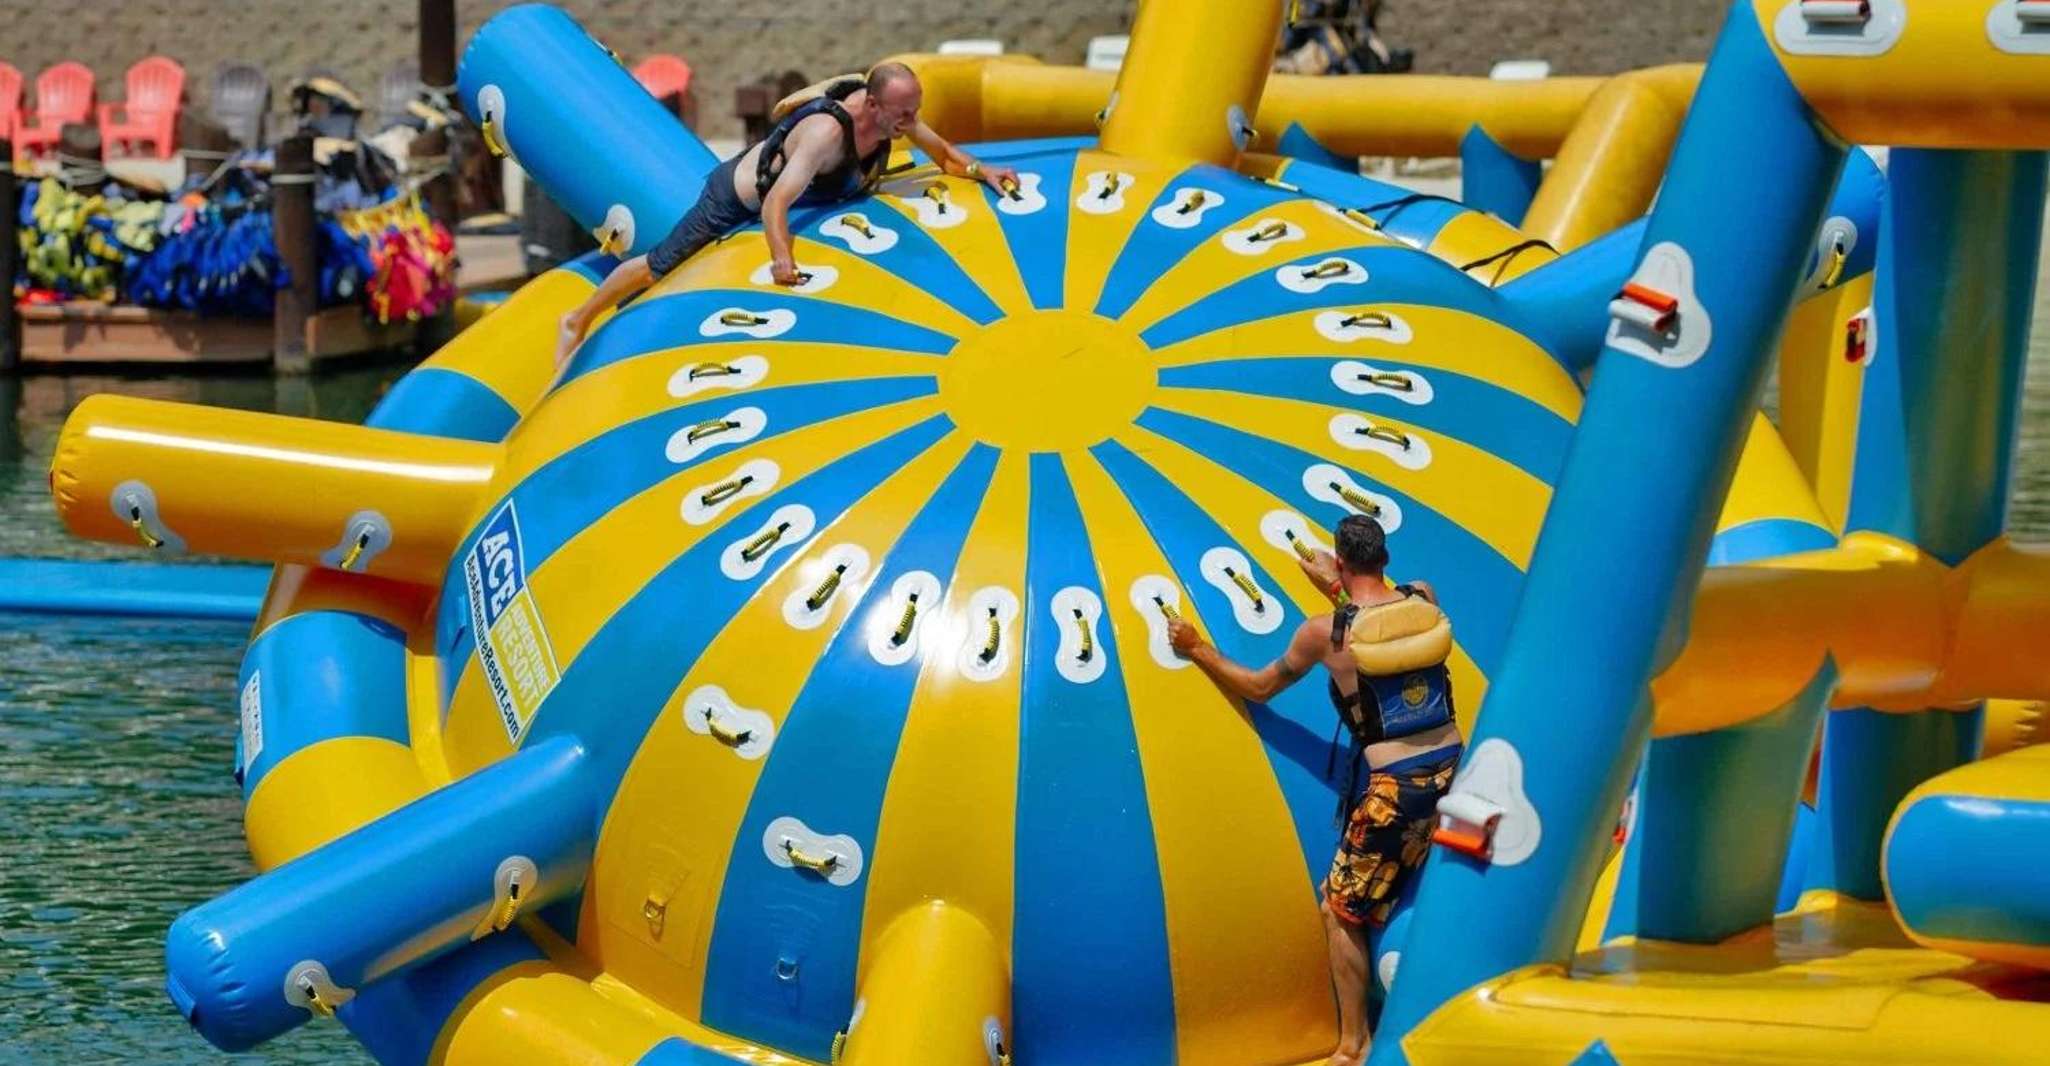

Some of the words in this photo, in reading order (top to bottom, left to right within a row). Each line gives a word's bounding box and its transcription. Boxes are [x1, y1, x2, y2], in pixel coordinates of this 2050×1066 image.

[482, 530, 516, 618] ACE
[497, 614, 538, 707] RESORT
[512, 602, 550, 690] ADVENTURE
